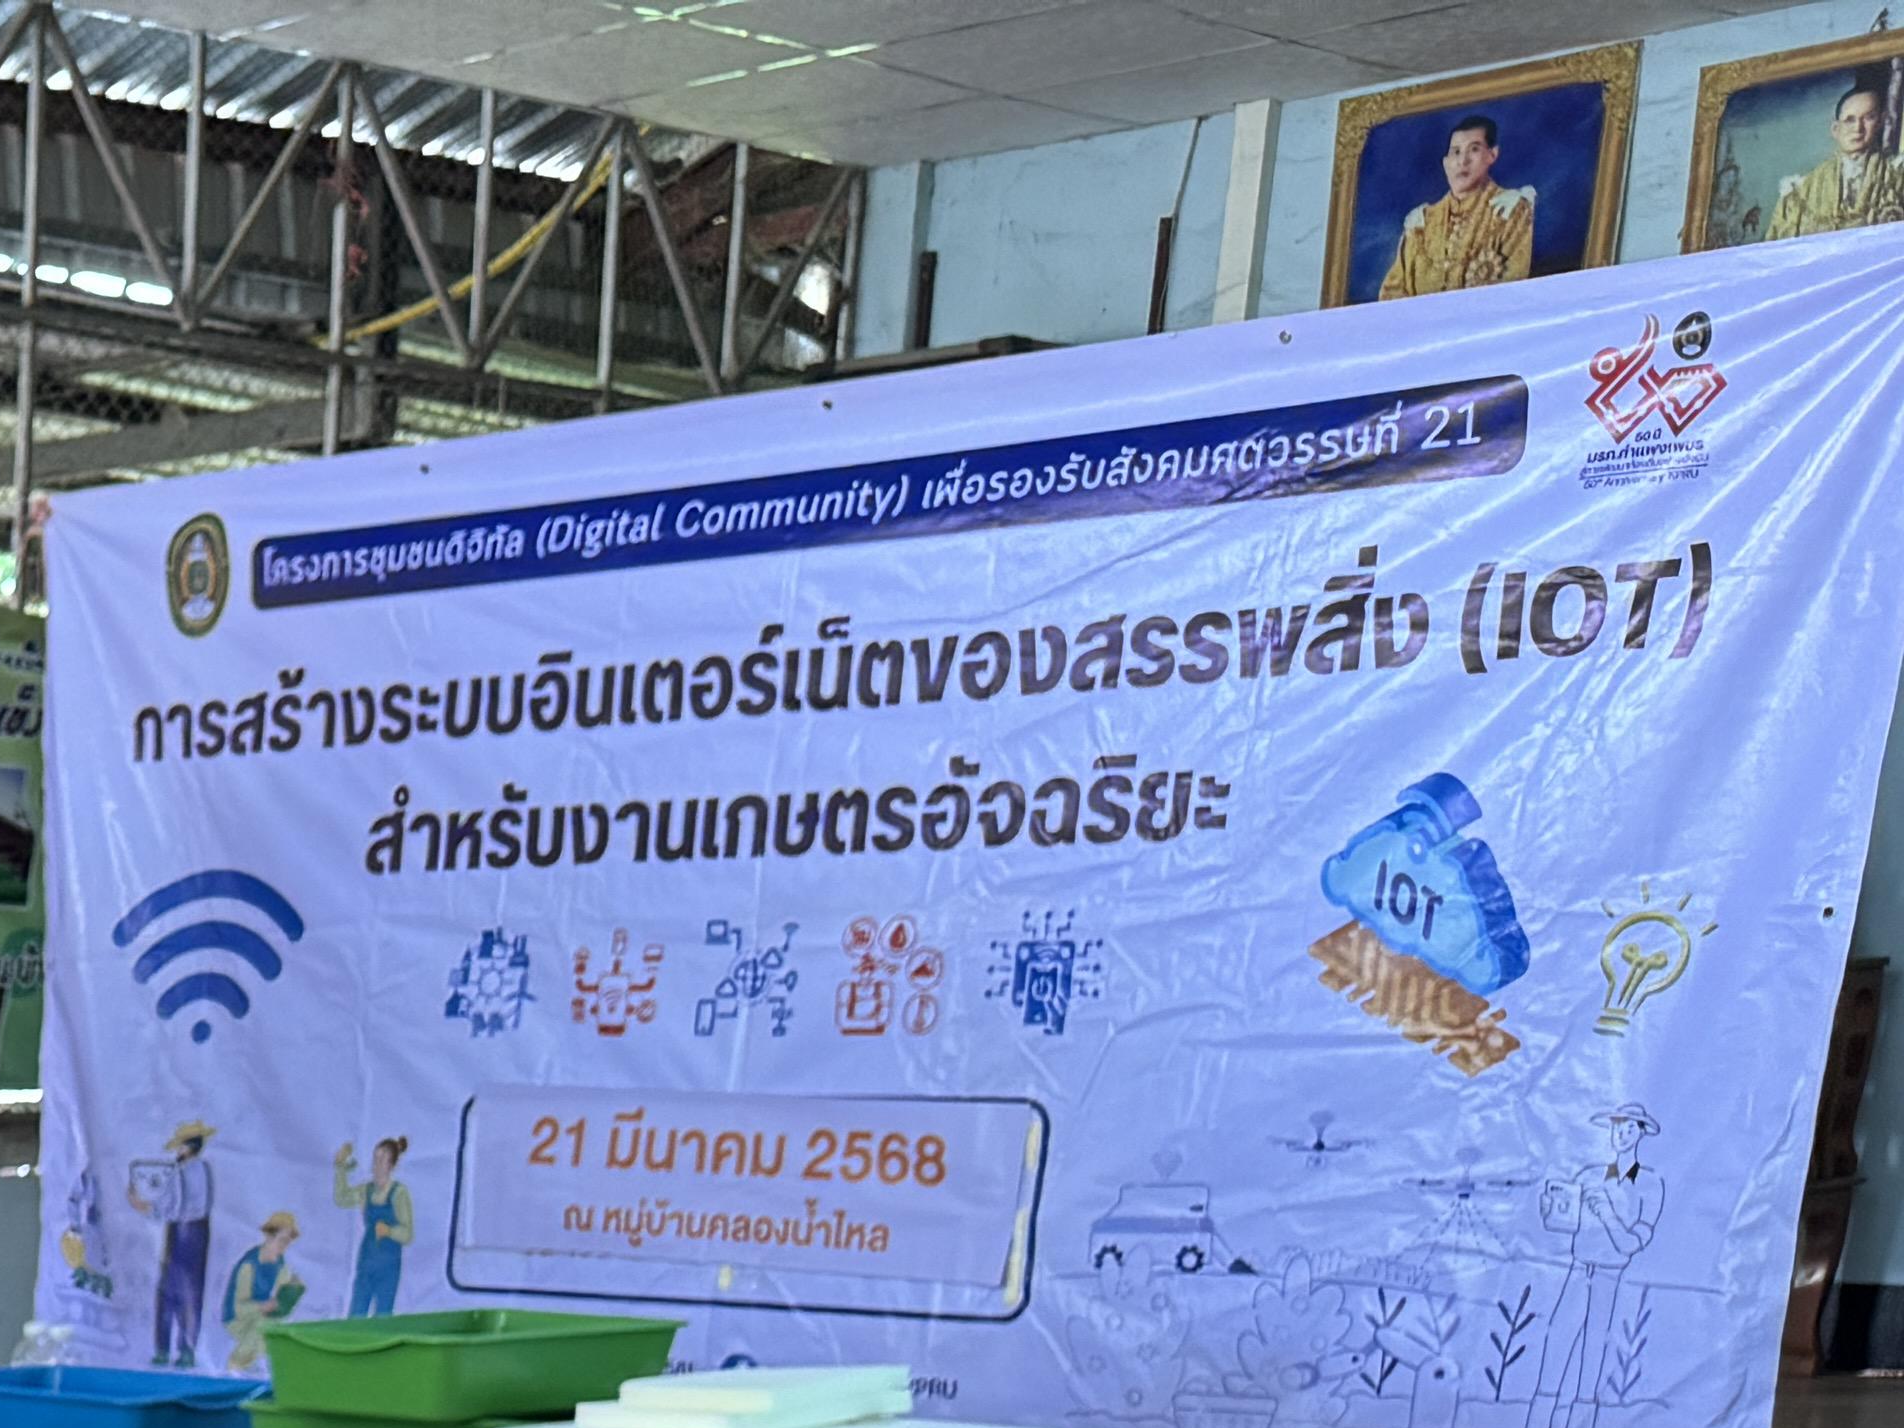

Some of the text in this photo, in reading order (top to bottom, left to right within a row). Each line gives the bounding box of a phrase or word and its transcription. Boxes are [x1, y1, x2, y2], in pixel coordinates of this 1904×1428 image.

[261, 397, 1483, 592] โครงการชุมชนดิจิทัล (Digital Community) เพื่อรองรับสังคมศตวรรษที่ 21
[134, 541, 1713, 764] การสร้างระบบอินเตอร์เน็ตของสรรพสิ่ง (IOT)
[365, 753, 1231, 877] สำหรับงานเกษตรอัจฉริยะ
[1373, 857, 1445, 942] IOT
[527, 1109, 949, 1189] 21 มีนาคม 2568
[562, 1197, 890, 1255] ณ หมู่บ้านคลองน้ำไหล
